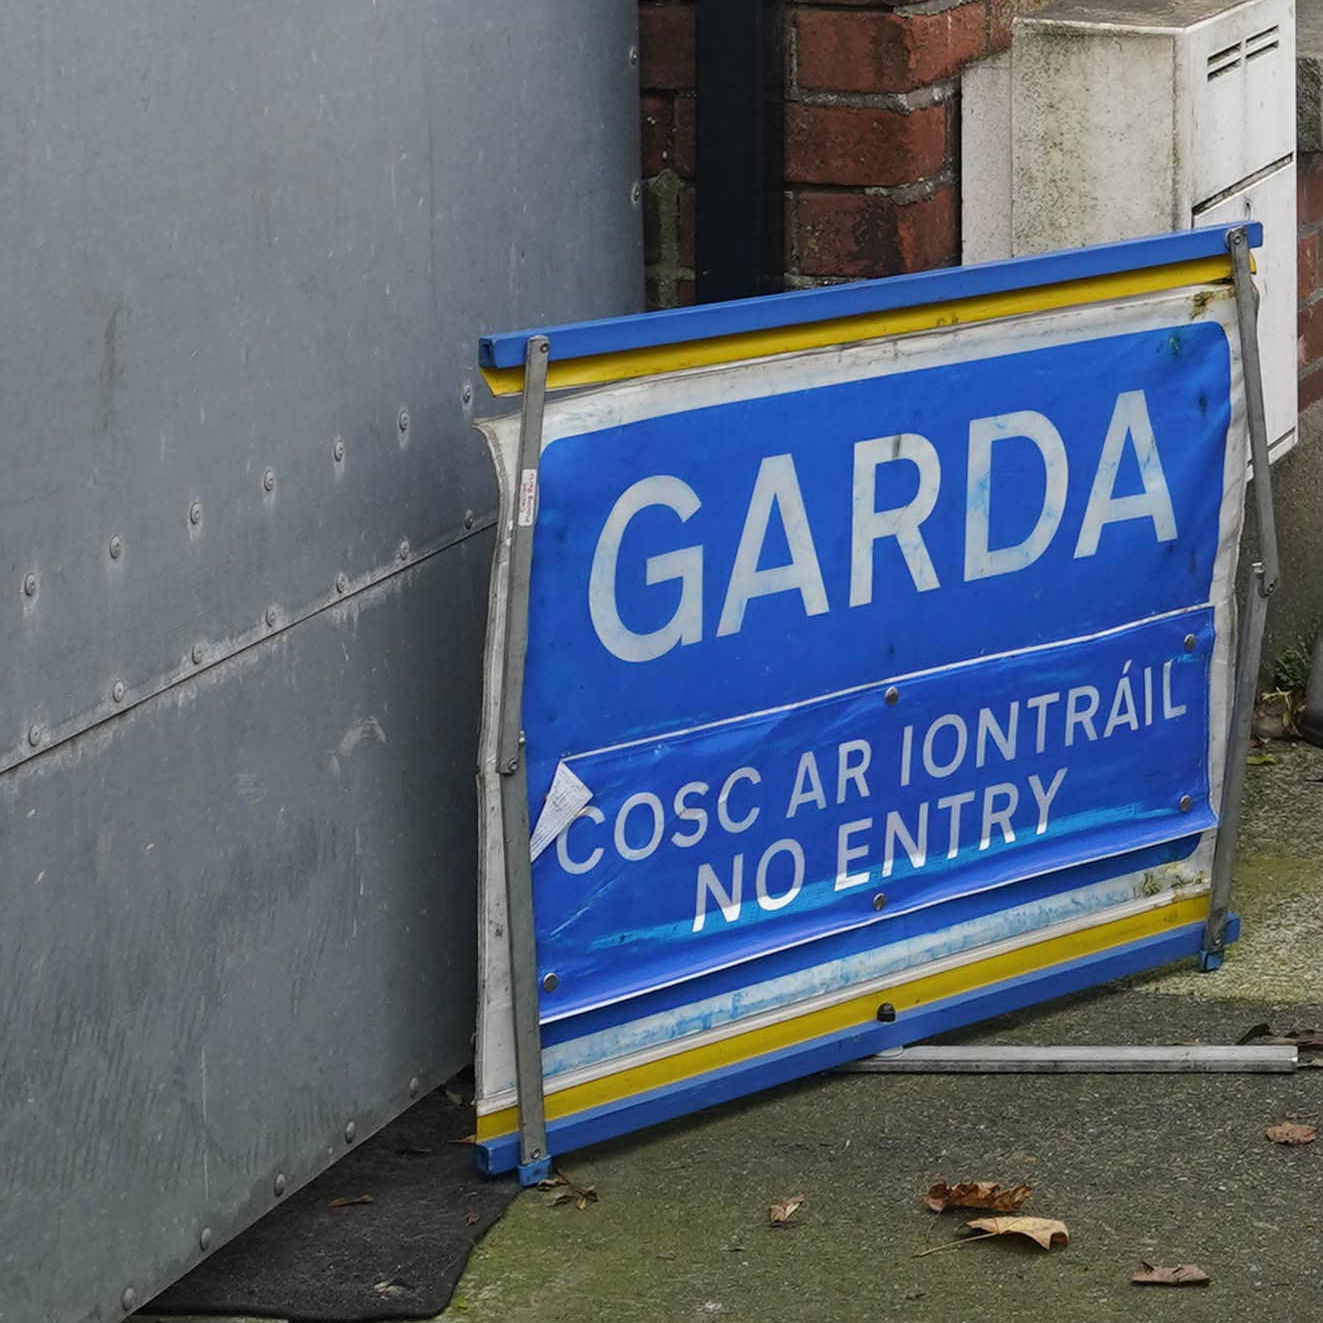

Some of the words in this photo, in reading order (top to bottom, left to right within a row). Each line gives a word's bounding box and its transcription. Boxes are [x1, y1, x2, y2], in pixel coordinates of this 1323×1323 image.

[588, 389, 1178, 663] GARDA
[556, 767, 761, 876] COSC
[786, 739, 873, 815] AR
[900, 659, 1187, 787] IONTRÁIL
[691, 839, 805, 933] NO
[833, 768, 1068, 893] ENTRY
